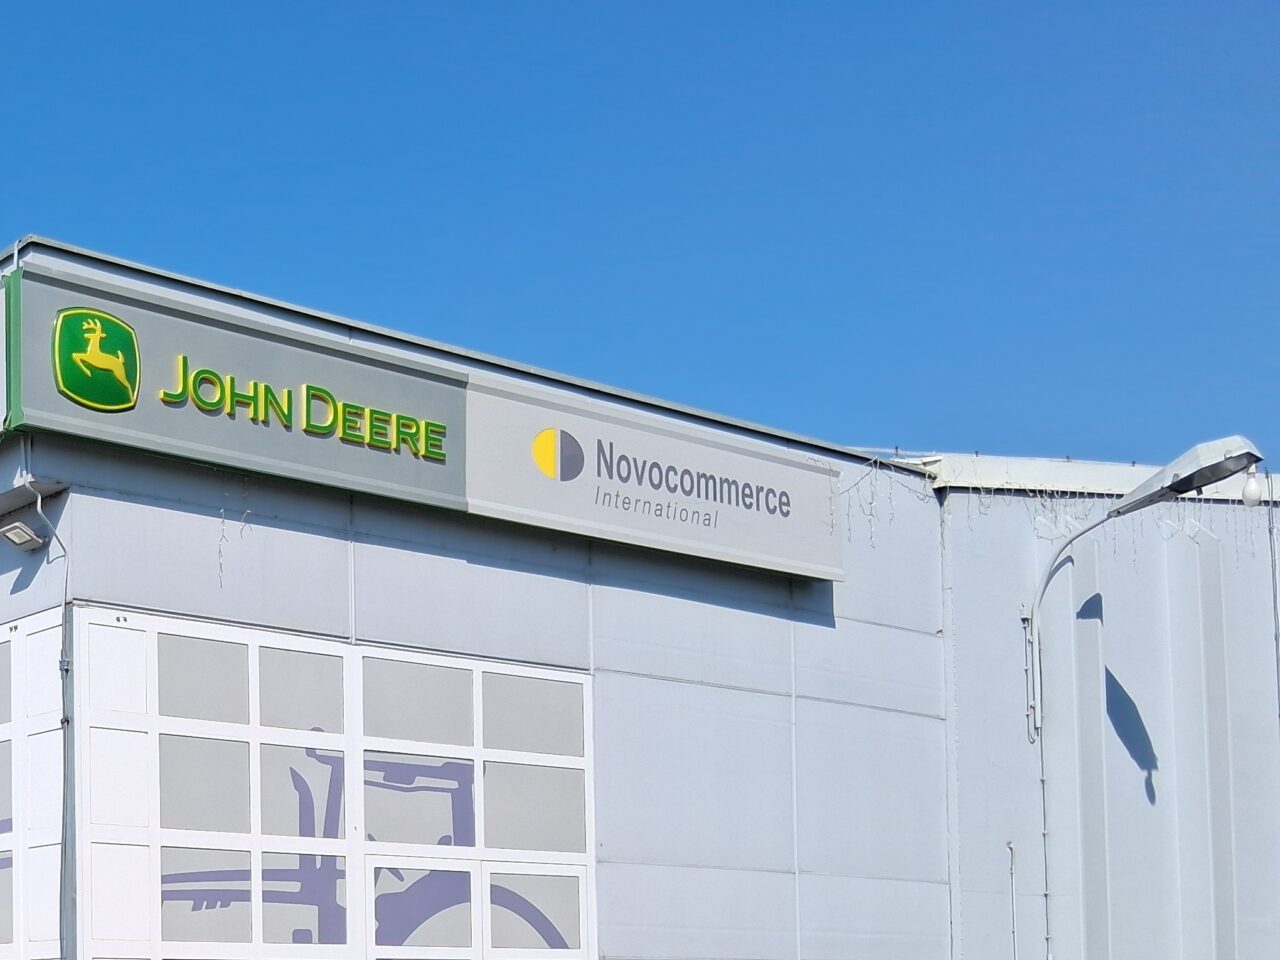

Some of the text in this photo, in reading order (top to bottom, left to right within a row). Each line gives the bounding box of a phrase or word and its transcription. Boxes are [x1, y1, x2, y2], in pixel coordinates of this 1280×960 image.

[159, 355, 447, 461] JOHN DEERE
[594, 486, 719, 529] International
[596, 439, 791, 518] Novocommerce
